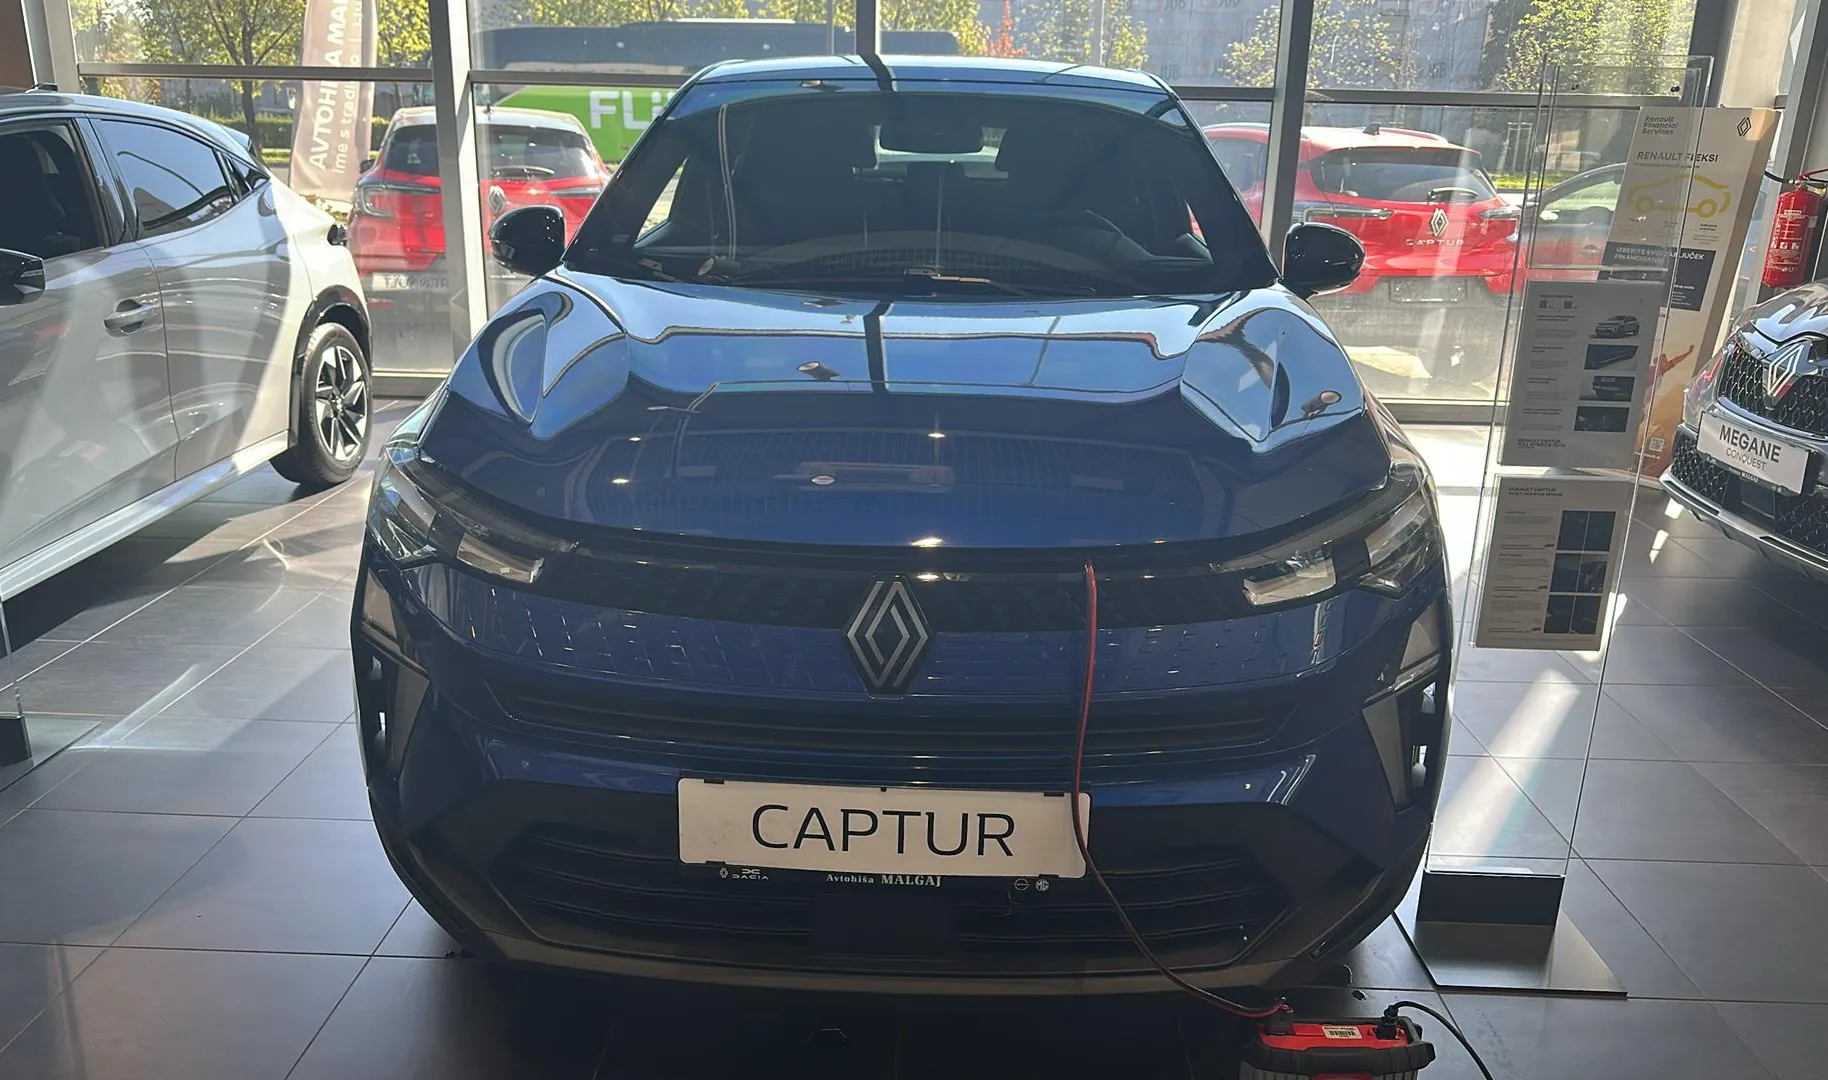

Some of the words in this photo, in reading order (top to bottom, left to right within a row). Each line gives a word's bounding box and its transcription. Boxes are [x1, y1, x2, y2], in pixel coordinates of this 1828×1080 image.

[341, 56, 360, 125] tradio
[309, 49, 342, 170] AVTOHIA
[1644, 115, 1675, 123] Renault
[340, 129, 350, 139] s
[1643, 121, 1679, 129] Financial
[332, 143, 348, 174] ime
[1636, 151, 1683, 162] RENAULT
[1720, 425, 1781, 463] MEGANE
[1726, 447, 1766, 470] CONQUEST
[751, 803, 1016, 857] CAPTUR
[826, 873, 874, 884] Avtohiša
[881, 875, 942, 888] MALGAJ
